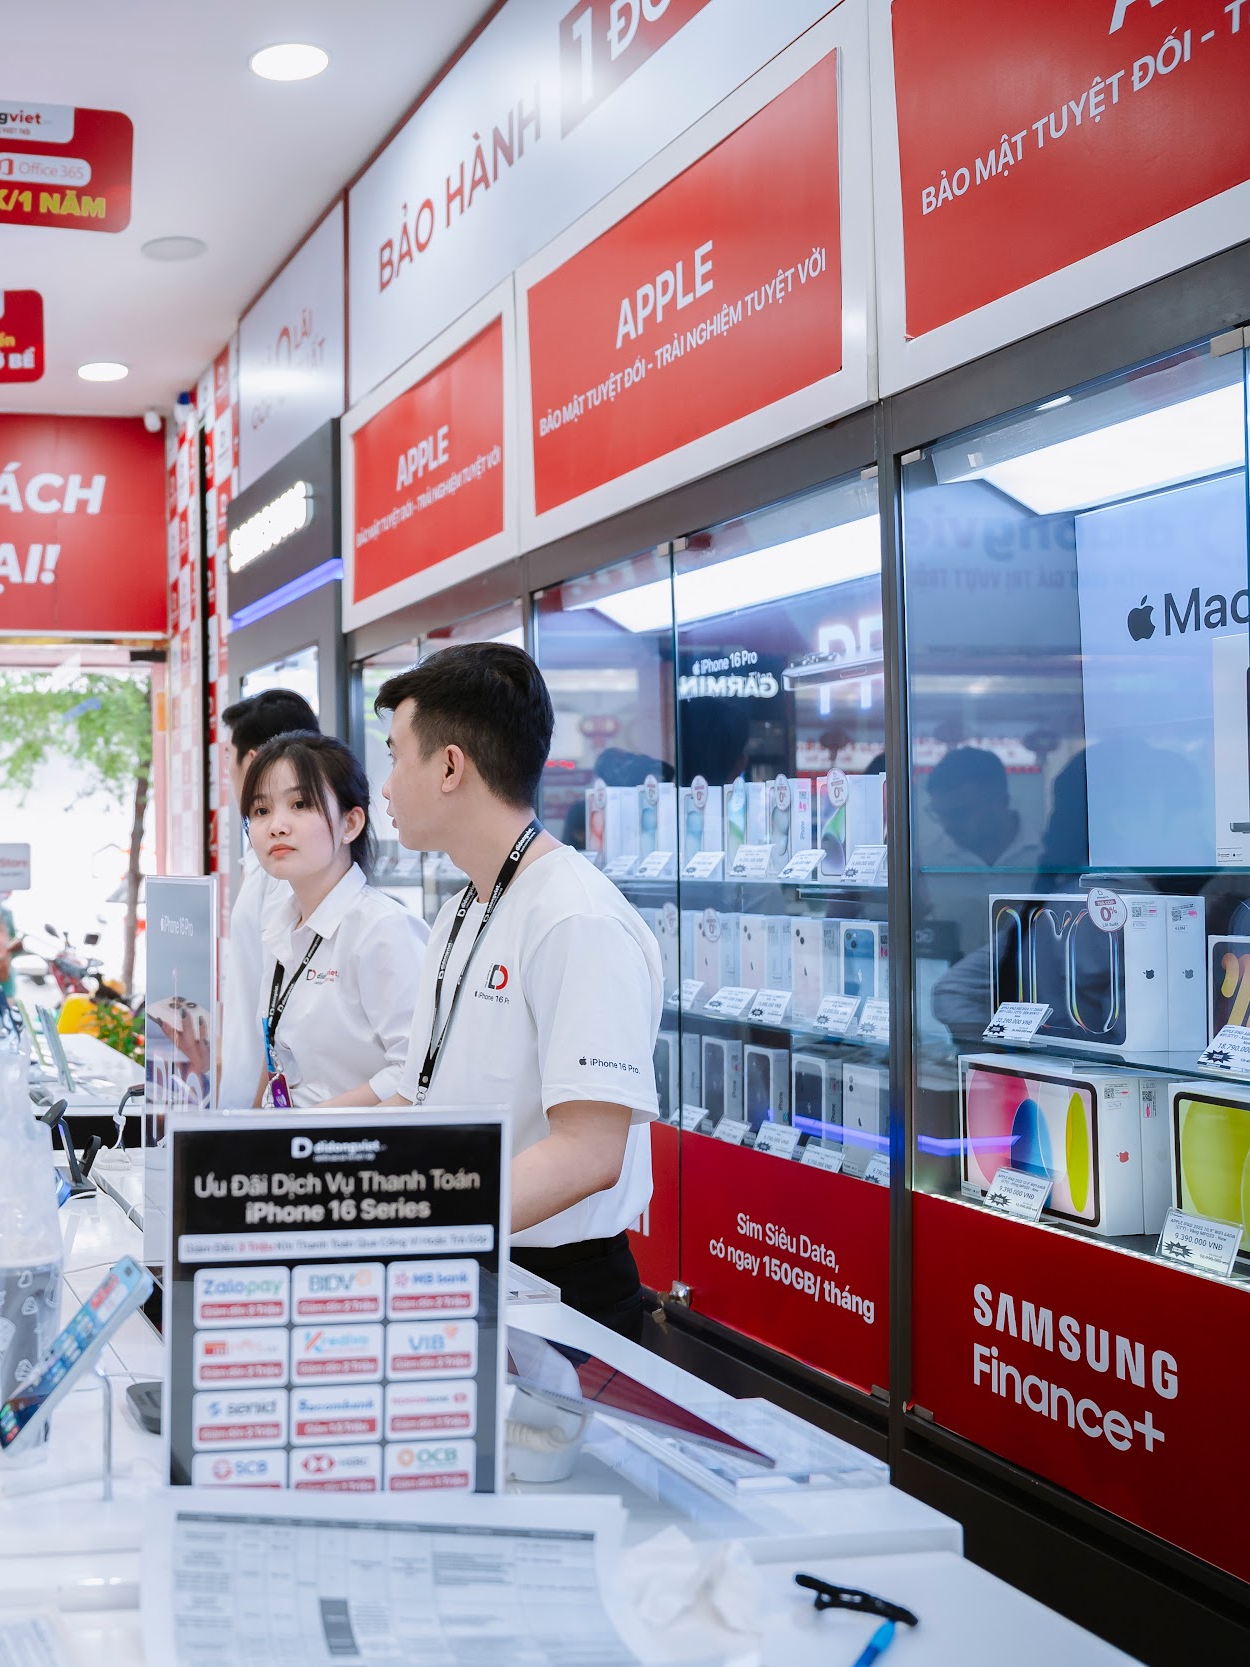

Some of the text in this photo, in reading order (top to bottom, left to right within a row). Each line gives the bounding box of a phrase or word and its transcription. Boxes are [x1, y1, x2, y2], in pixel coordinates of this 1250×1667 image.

[921, 26, 1192, 216] BẢO MẬT TUYỆT ĐỐI
[18, 161, 58, 177] Office
[60, 164, 84, 179] 365
[378, 202, 435, 293] BẢO
[445, 79, 541, 229] HÀNH
[39, 190, 106, 218] NĂM
[616, 239, 714, 350] APPLE
[586, 373, 623, 402] TUYỆT
[654, 333, 685, 370] TRẢI
[686, 304, 742, 353] NGHIỆM
[744, 267, 795, 317] TUYỆT
[396, 424, 449, 492] APPLE
[700, 649, 758, 675] iPhone 16 Pro
[589, 1057, 618, 1069] iPhone
[618, 1062, 627, 1071] 16
[271, 1172, 322, 1199] Dịch
[358, 1169, 426, 1193] Thanh
[430, 1167, 481, 1190] Toán
[245, 1196, 431, 1224] iPhone 16 Series
[737, 1212, 840, 1273] Sim Siêu Data,
[1174, 1232, 1224, 1251] 9.390.000 VNĐ
[308, 1273, 355, 1292] BIDV
[709, 1237, 875, 1324] có ngay 150GB/ tháng
[408, 1333, 445, 1351] VIB
[973, 1283, 1179, 1400] SAMSUNG
[973, 1342, 1165, 1453] Finance+
[416, 1447, 458, 1463] OCB
